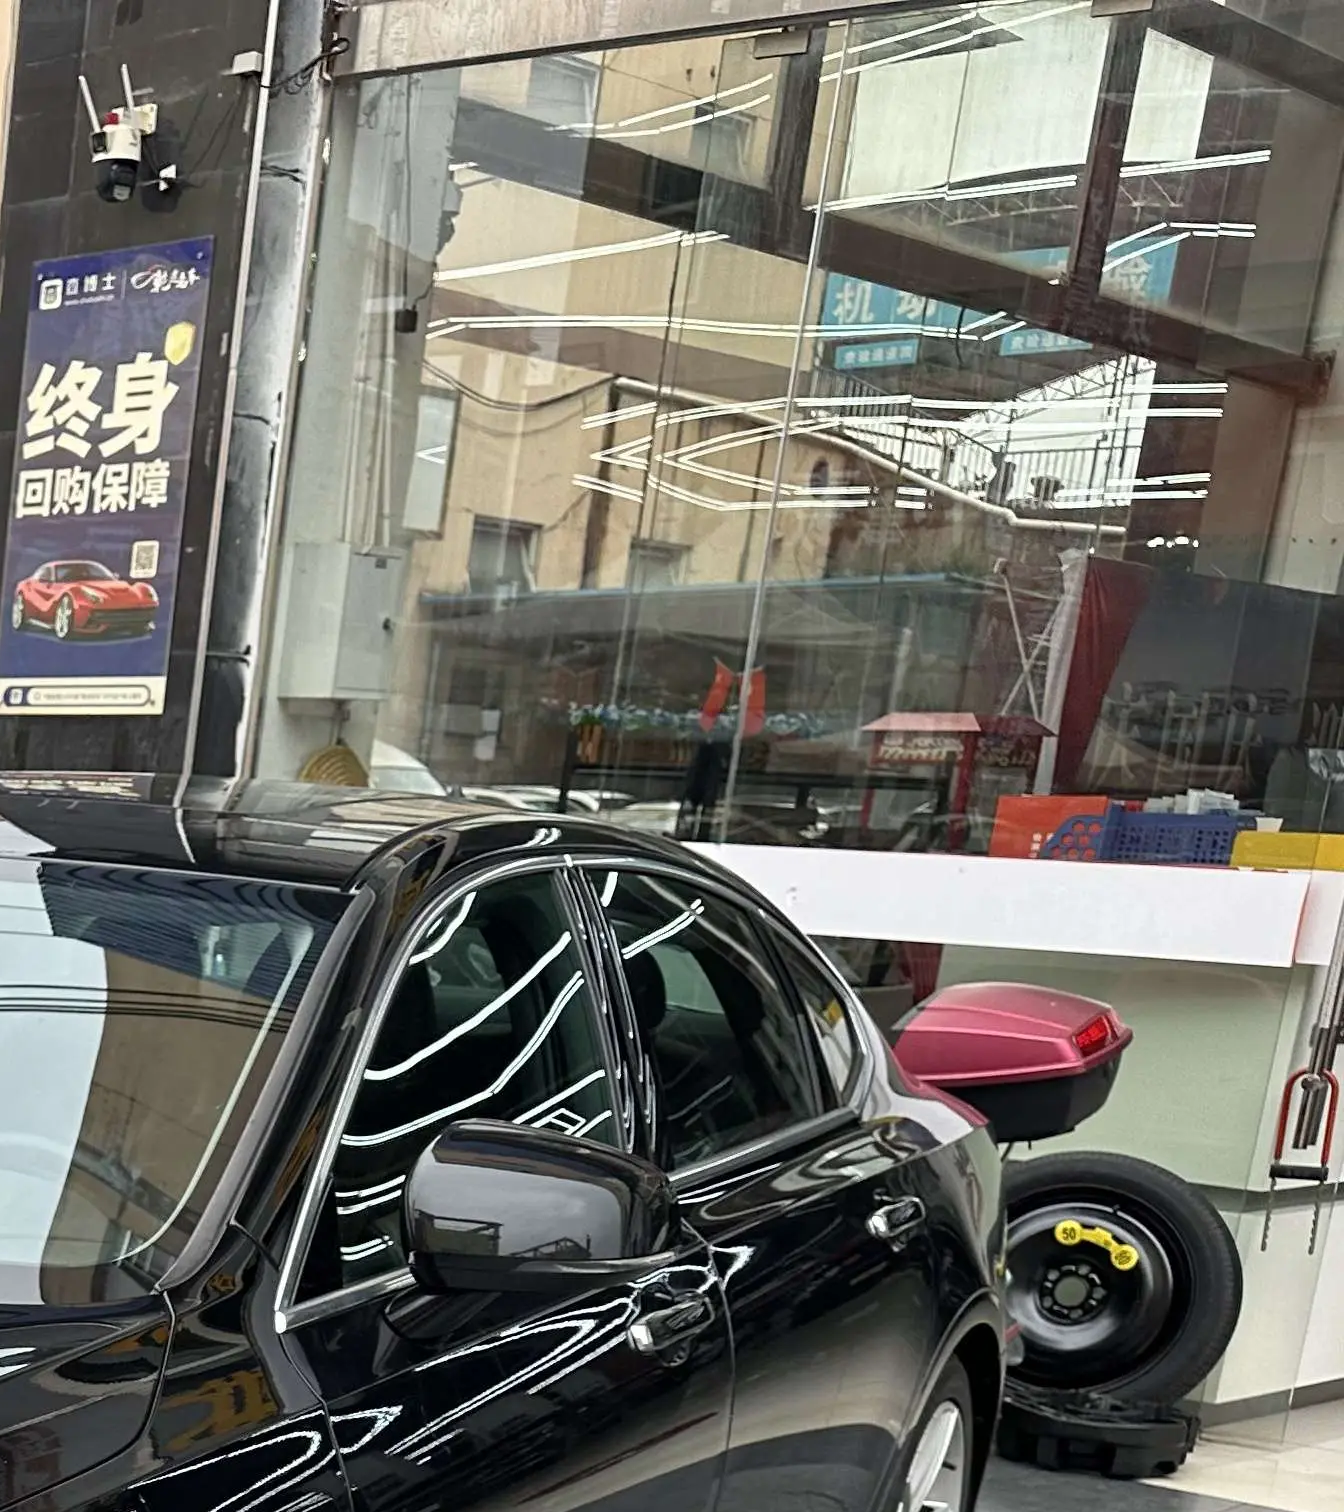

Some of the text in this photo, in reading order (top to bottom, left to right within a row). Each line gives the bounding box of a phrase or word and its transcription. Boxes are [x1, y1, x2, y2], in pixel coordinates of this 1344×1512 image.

[22, 352, 180, 460] 终身
[15, 459, 171, 519] 回购保障
[1061, 1226, 1077, 1242] 50
